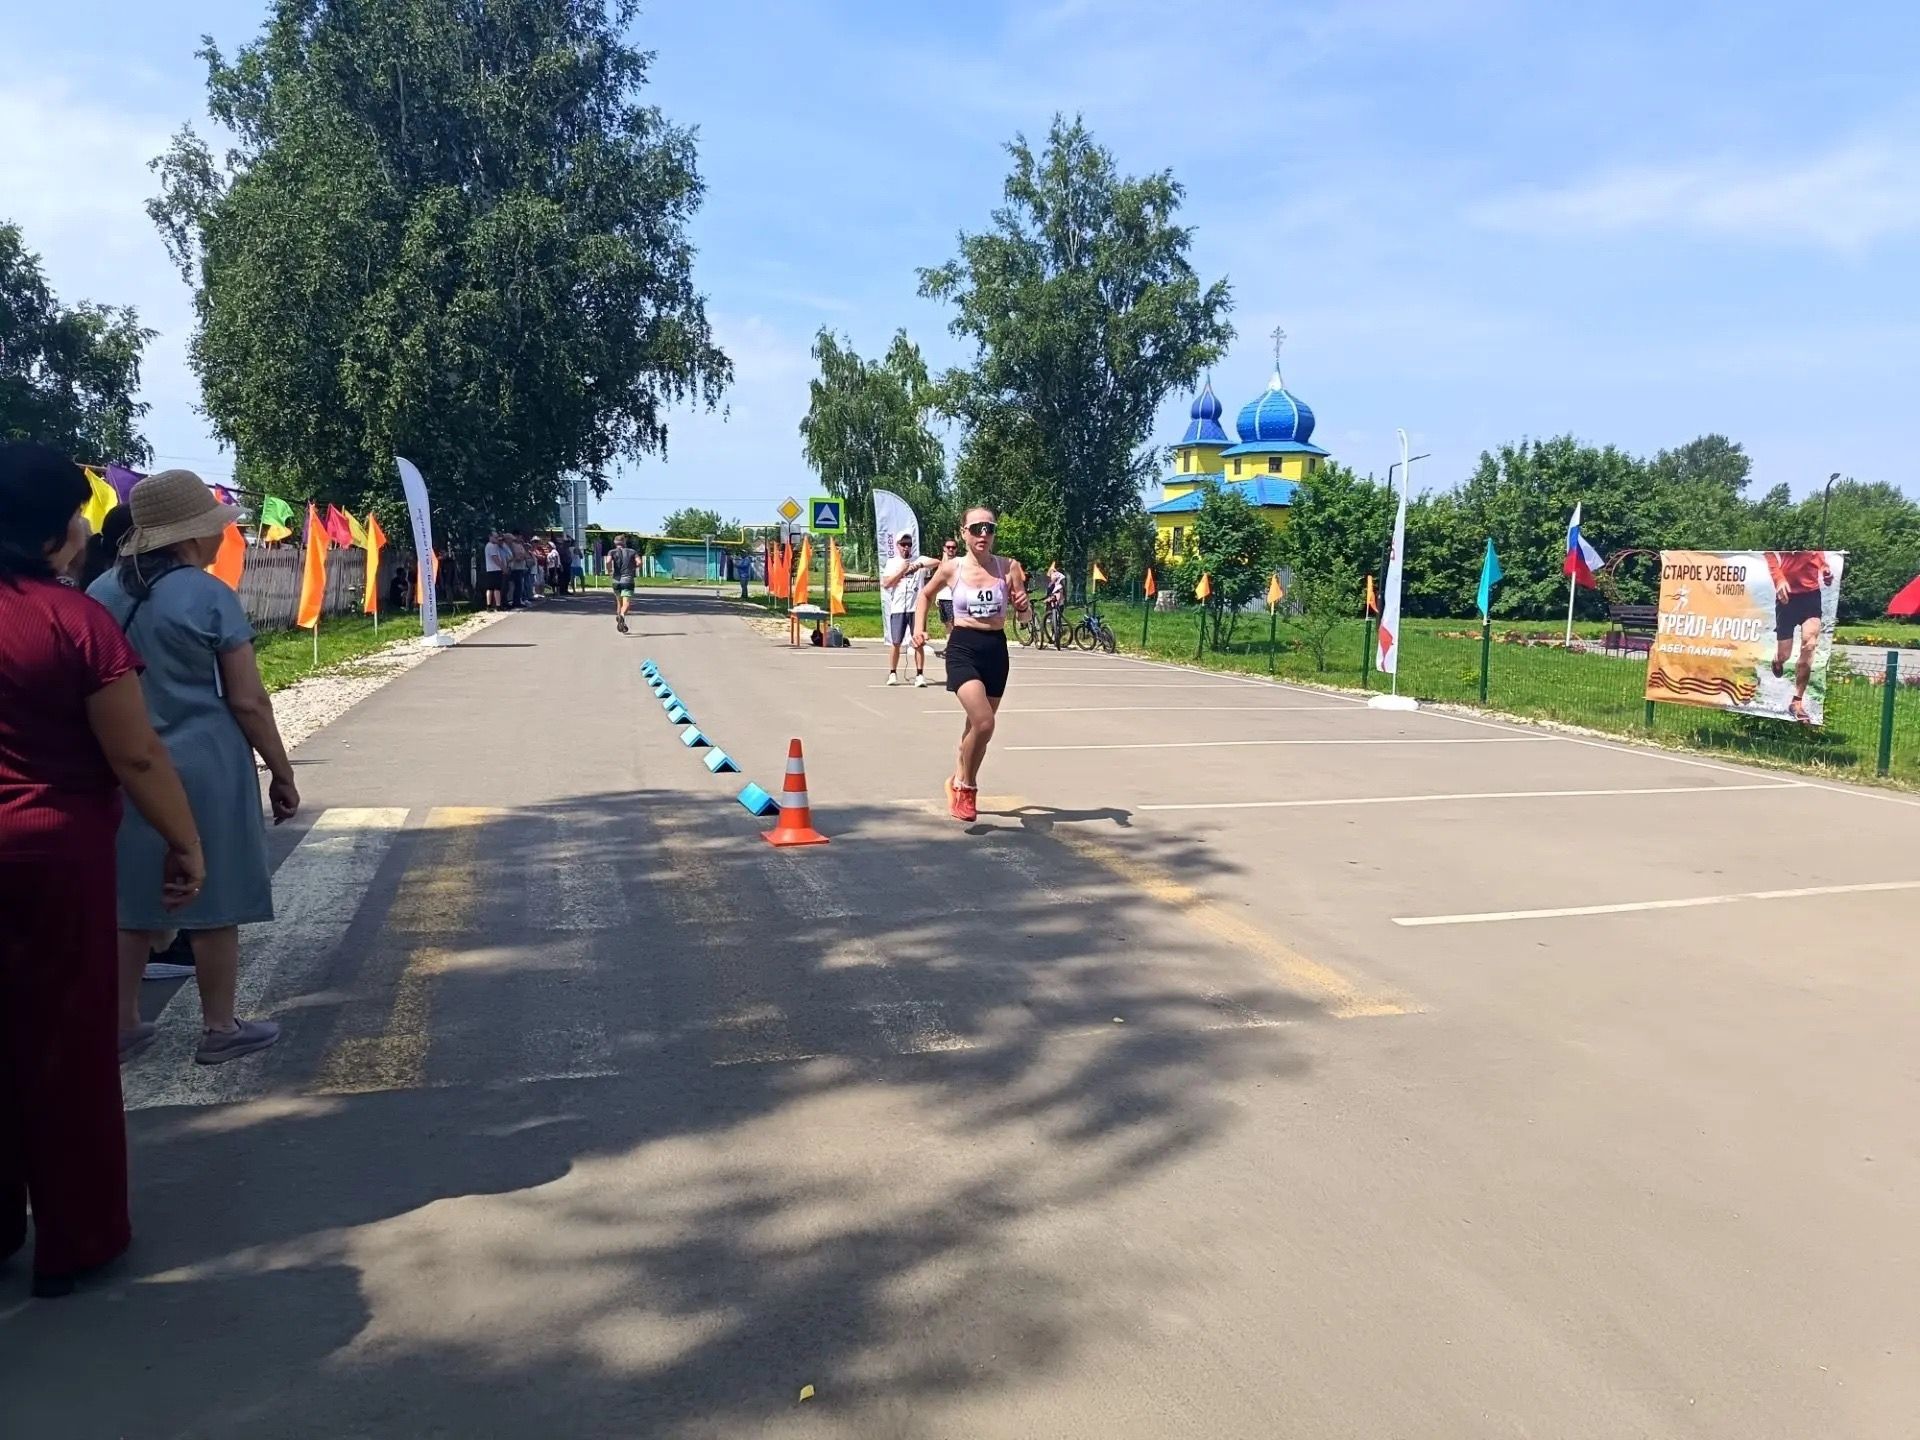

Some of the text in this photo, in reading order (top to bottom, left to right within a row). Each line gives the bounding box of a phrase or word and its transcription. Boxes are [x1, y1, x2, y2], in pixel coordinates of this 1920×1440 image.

[887, 533, 896, 559] хәрә
[1663, 565, 1747, 582] СТАРОЕ УЗЕЕВО
[977, 590, 993, 602] 40
[1716, 583, 1745, 596] 5 ИЮЛЯ
[1658, 611, 1762, 642] ТРЕЙЛ-КРОСС
